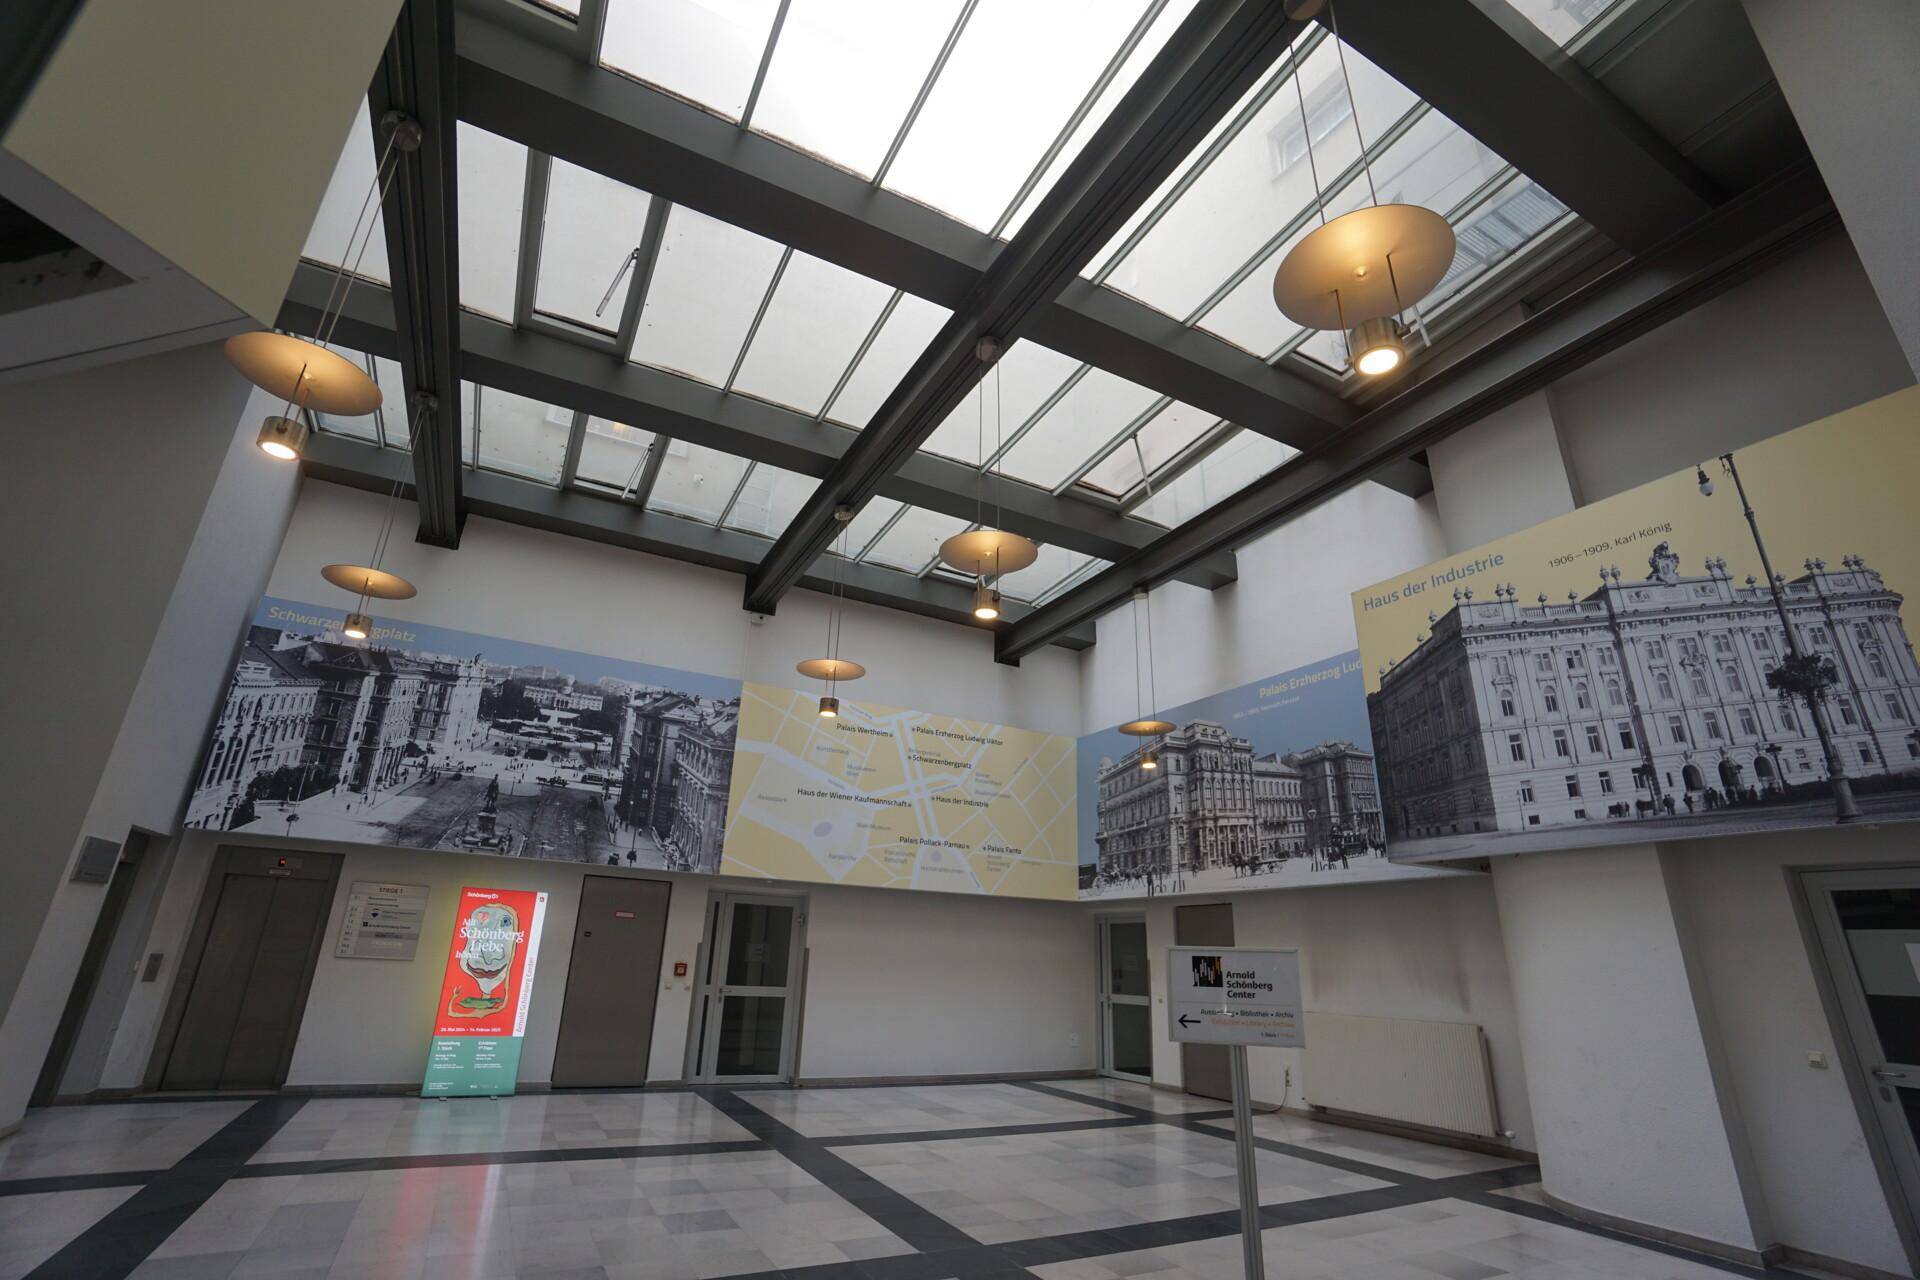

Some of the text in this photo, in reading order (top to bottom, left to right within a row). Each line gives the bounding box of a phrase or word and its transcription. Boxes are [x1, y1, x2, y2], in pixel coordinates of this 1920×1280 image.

[1615, 532, 1637, 546] Karl
[1639, 522, 1672, 539] König
[1363, 554, 1504, 611] Haus der Industrie
[1259, 682, 1288, 698] Palais
[1289, 666, 1341, 689] Erzherzog
[837, 723, 889, 737] Palais Wertheim
[916, 726, 934, 736] Palais
[935, 729, 964, 742] Erzherzog
[965, 734, 986, 745] Ludwig
[912, 754, 972, 769] Schwarzenbergplatz
[797, 788, 908, 808] Haus der Wiener Kaufmannschaft
[936, 796, 989, 808] Haus der Industrie
[900, 835, 918, 845] Palais
[987, 844, 1004, 853] Palais
[459, 927, 525, 944] Schönberg
[470, 939, 504, 952] Liebe
[1226, 970, 1255, 979] Arnold
[1226, 980, 1273, 991] Schönberg
[1227, 990, 1256, 999] Center
[1275, 1010, 1294, 1018] Archiv
